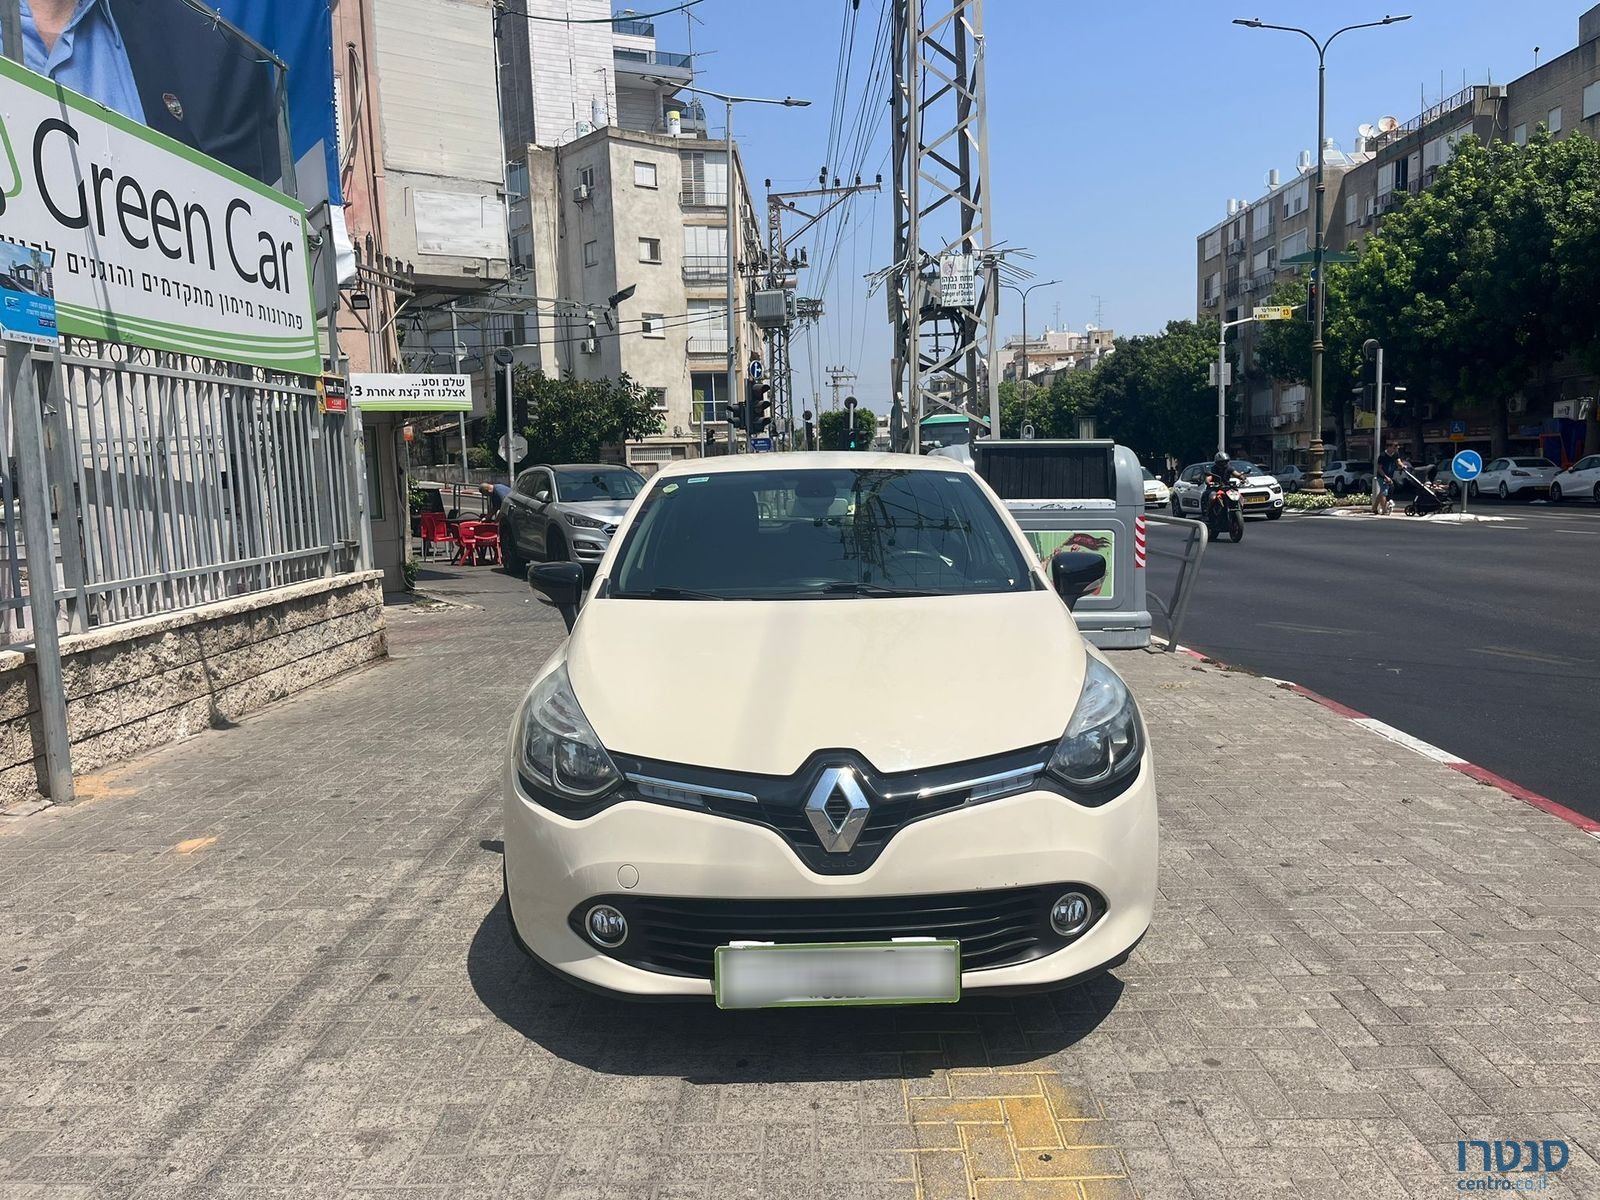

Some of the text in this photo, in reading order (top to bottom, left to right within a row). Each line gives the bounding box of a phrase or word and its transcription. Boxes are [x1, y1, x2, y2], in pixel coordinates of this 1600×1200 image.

[33, 118, 293, 294] Green Car
[67, 252, 303, 330] פתרונות מימון מתקדמים והוגנים
[442, 377, 465, 387] שלם
[367, 388, 395, 397] אחרת
[399, 388, 420, 399] קצת
[424, 388, 435, 397] זה
[438, 387, 466, 397] אצלנו
